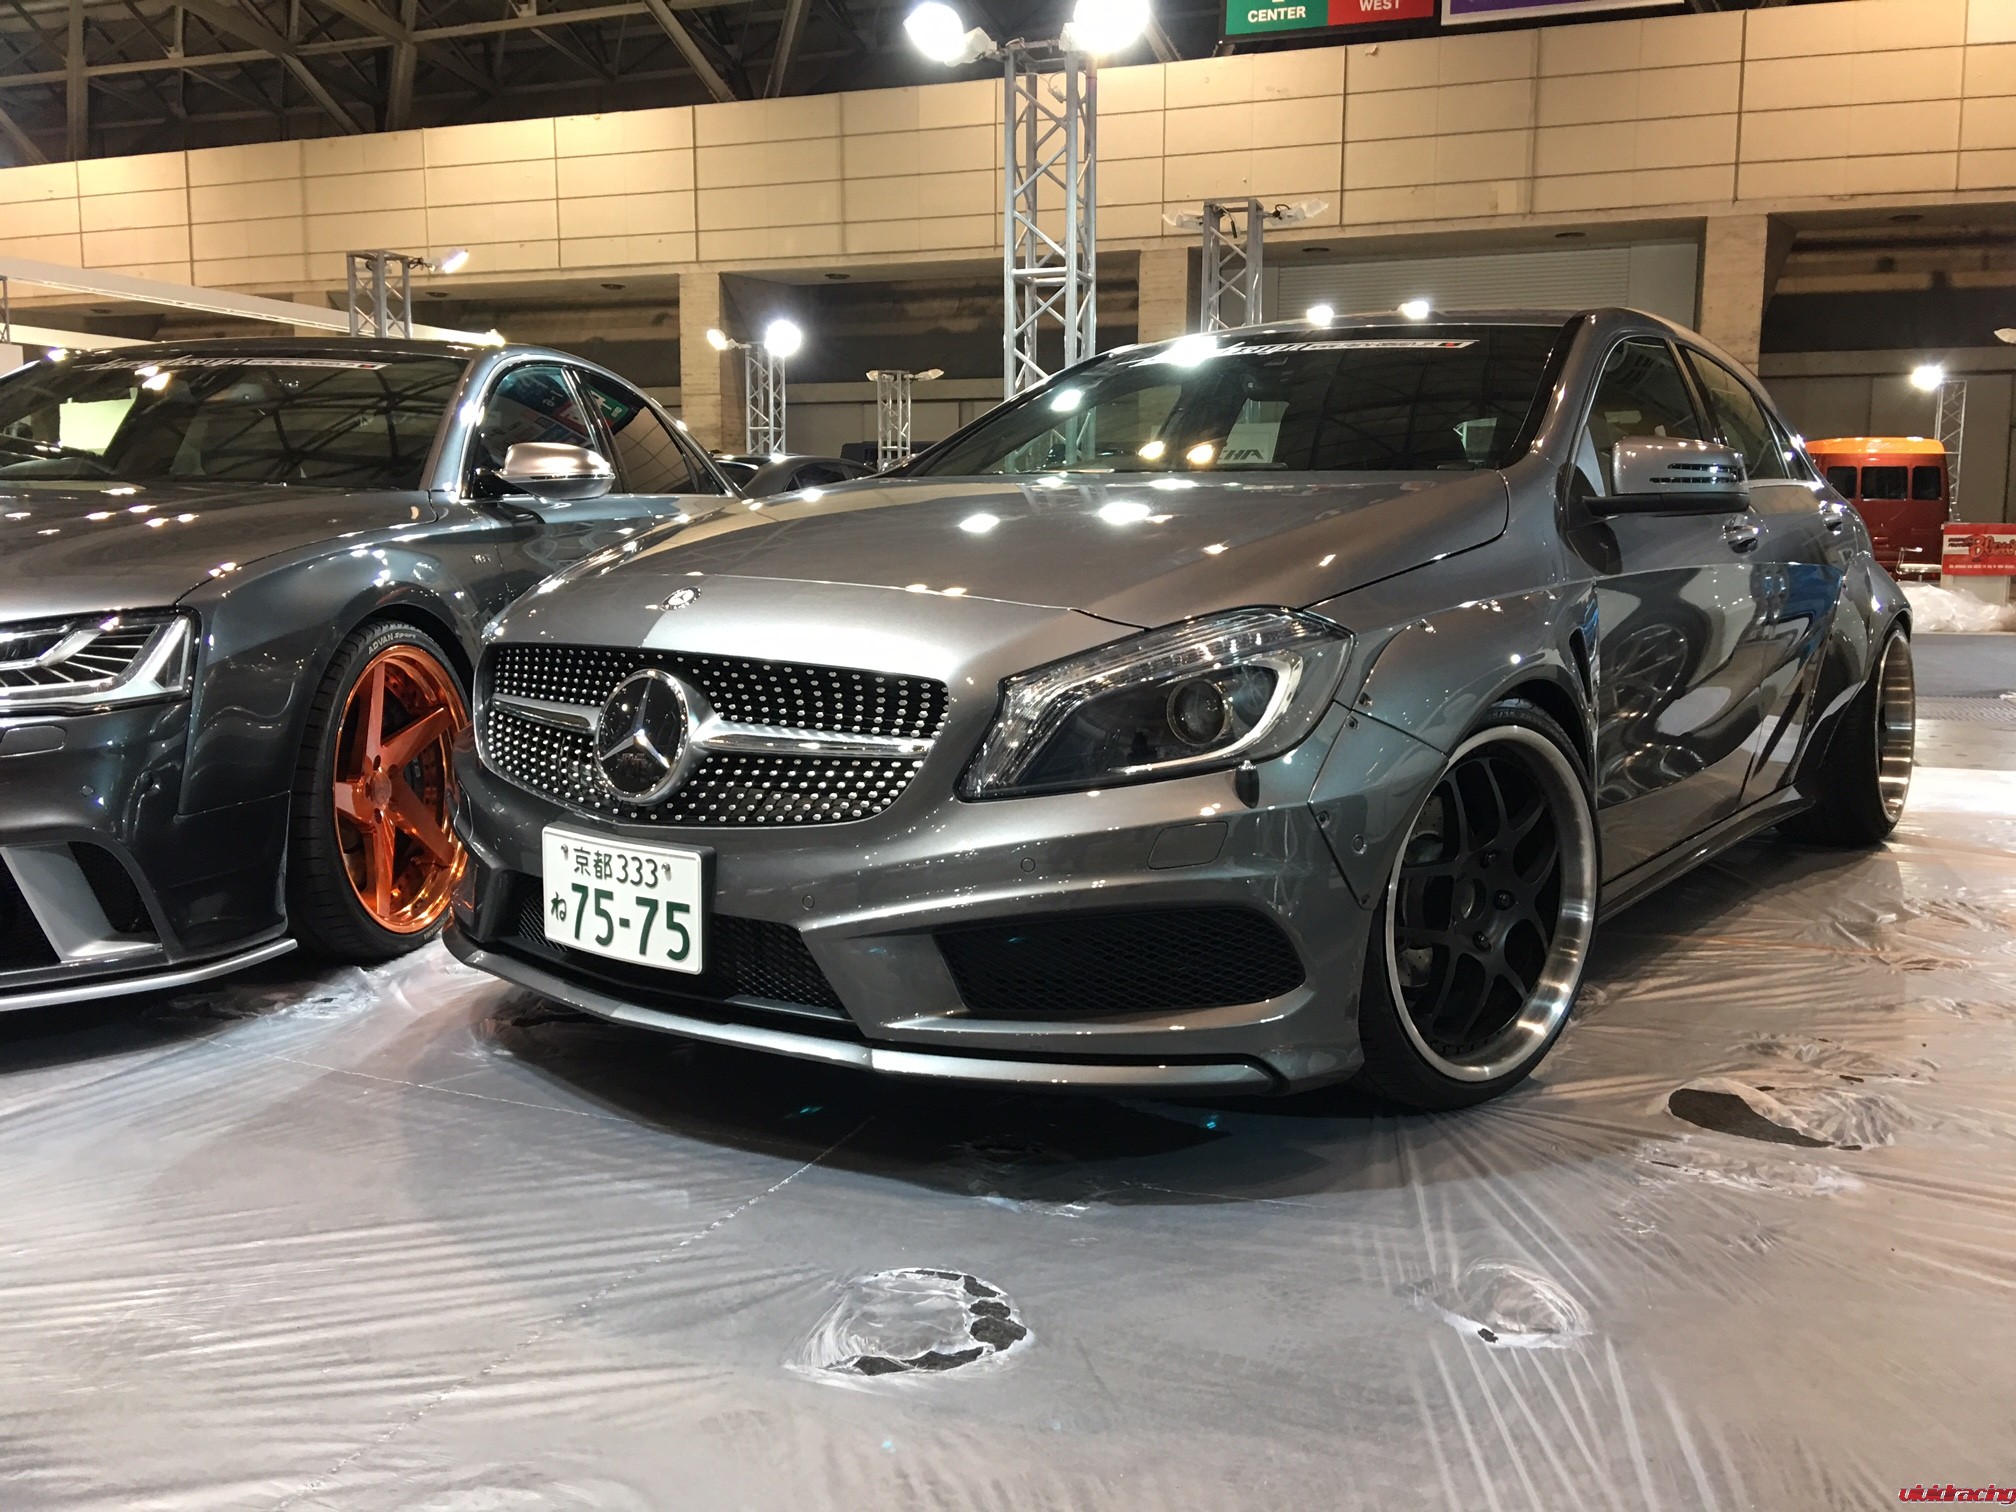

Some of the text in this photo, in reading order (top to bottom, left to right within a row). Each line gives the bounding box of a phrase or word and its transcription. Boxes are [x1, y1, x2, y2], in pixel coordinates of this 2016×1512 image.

[1248, 6, 1306, 23] CENTER
[368, 633, 394, 655] ADVAN
[573, 847, 659, 888] 京都 333
[550, 882, 691, 961] ね 75-75
